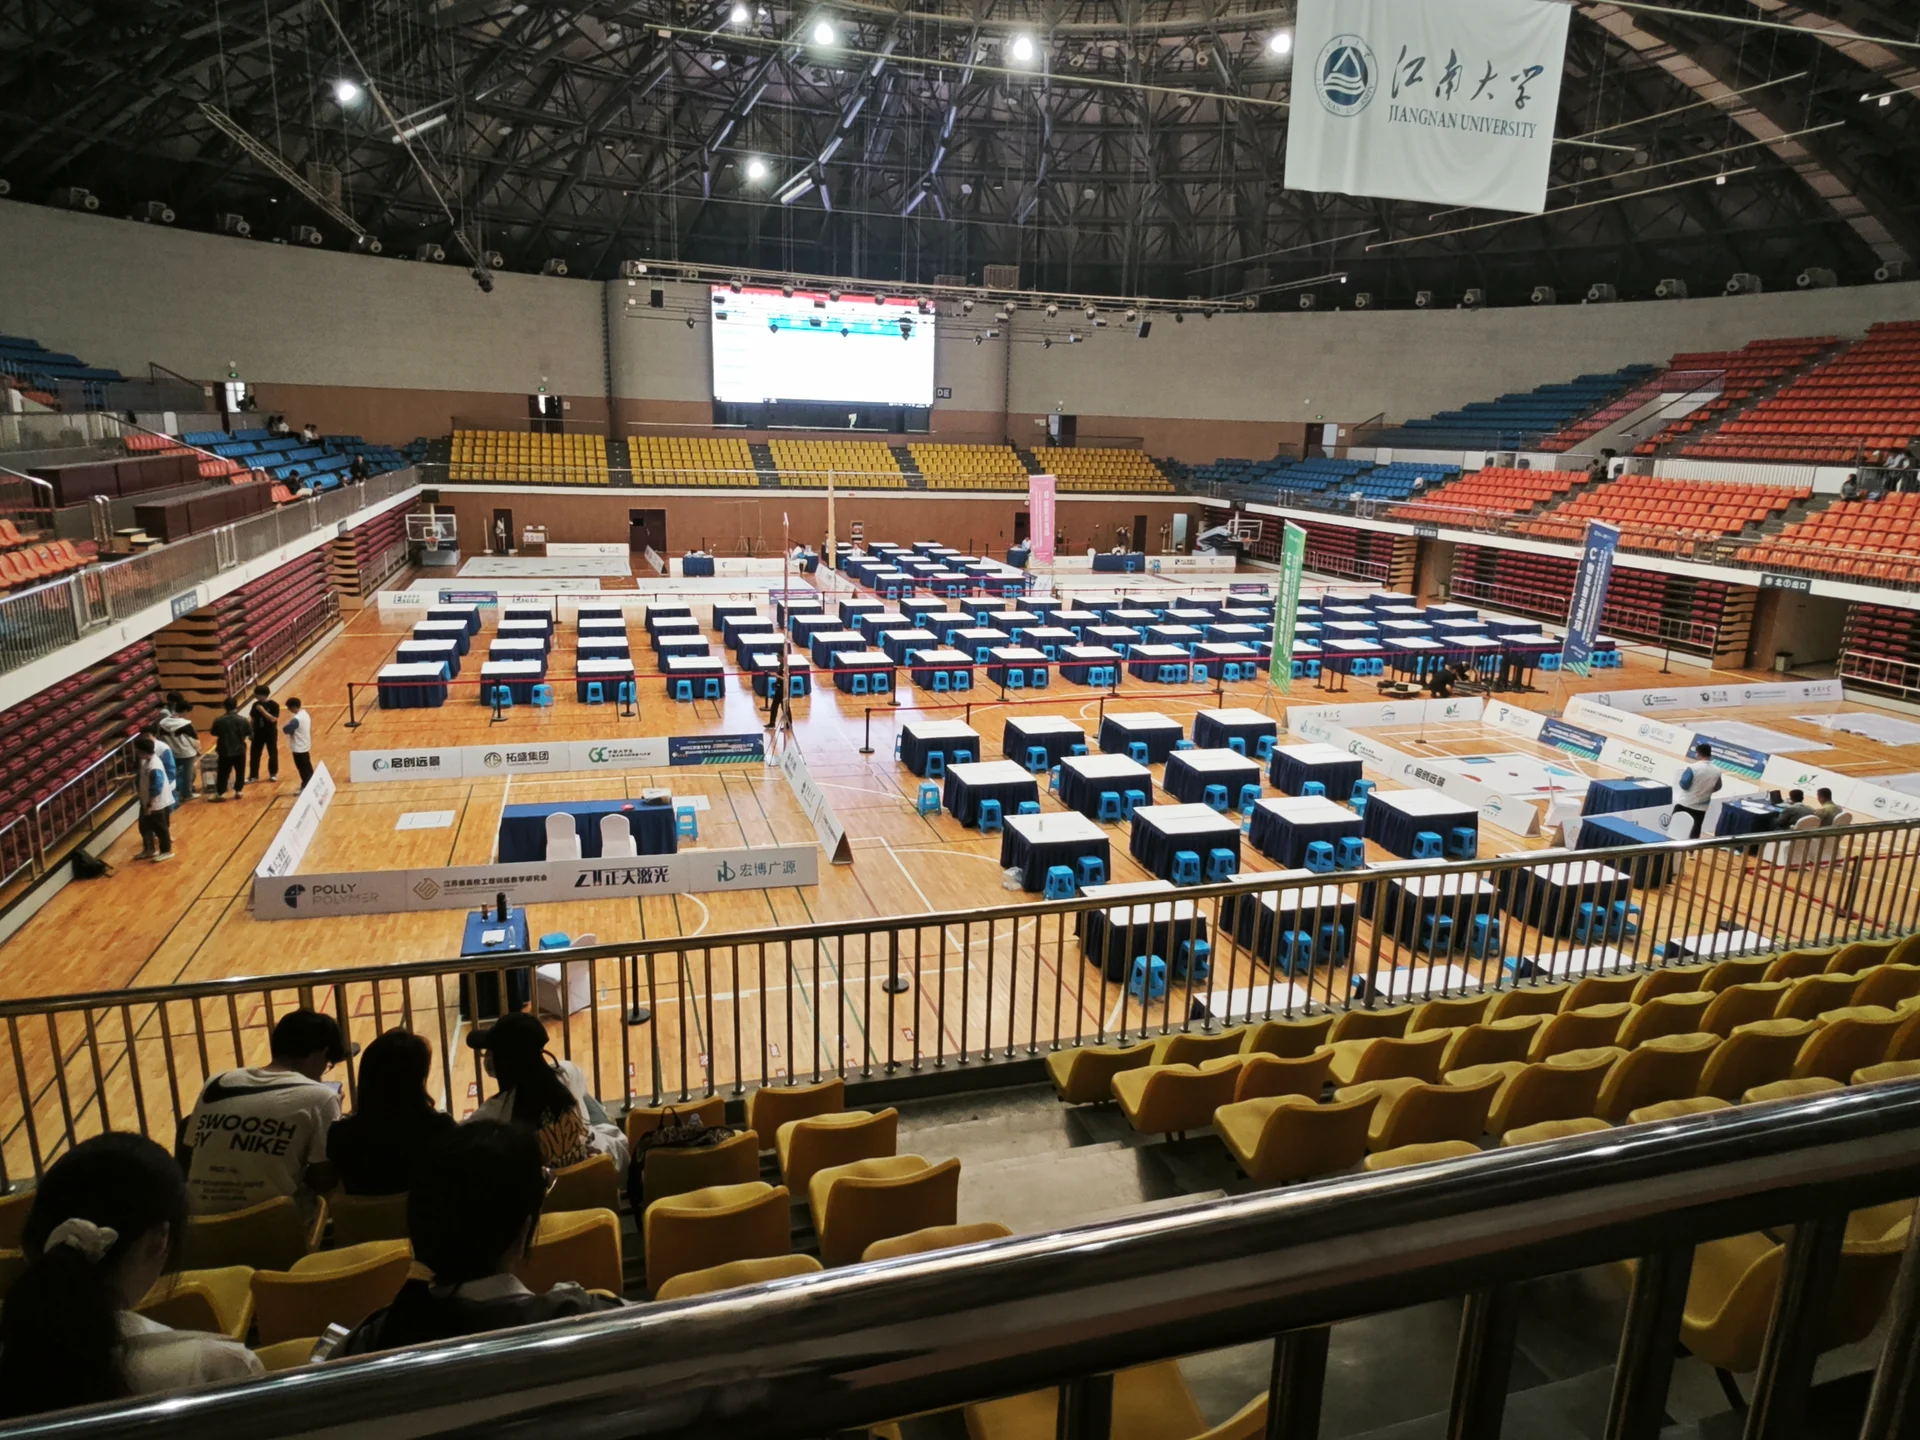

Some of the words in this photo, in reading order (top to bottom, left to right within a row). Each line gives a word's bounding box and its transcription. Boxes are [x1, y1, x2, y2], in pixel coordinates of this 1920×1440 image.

[1391, 44, 1544, 109] 江南大学
[1388, 104, 1458, 129] JIANGNAN
[1461, 114, 1538, 139] UNIVERSITY
[391, 756, 440, 769] 启创远景
[506, 751, 550, 762] 拓盛集团
[740, 860, 797, 877] 宏博广源
[312, 883, 357, 895] POLLY
[197, 1113, 297, 1139] SWOOSH
[229, 1133, 290, 1156] NIKE
